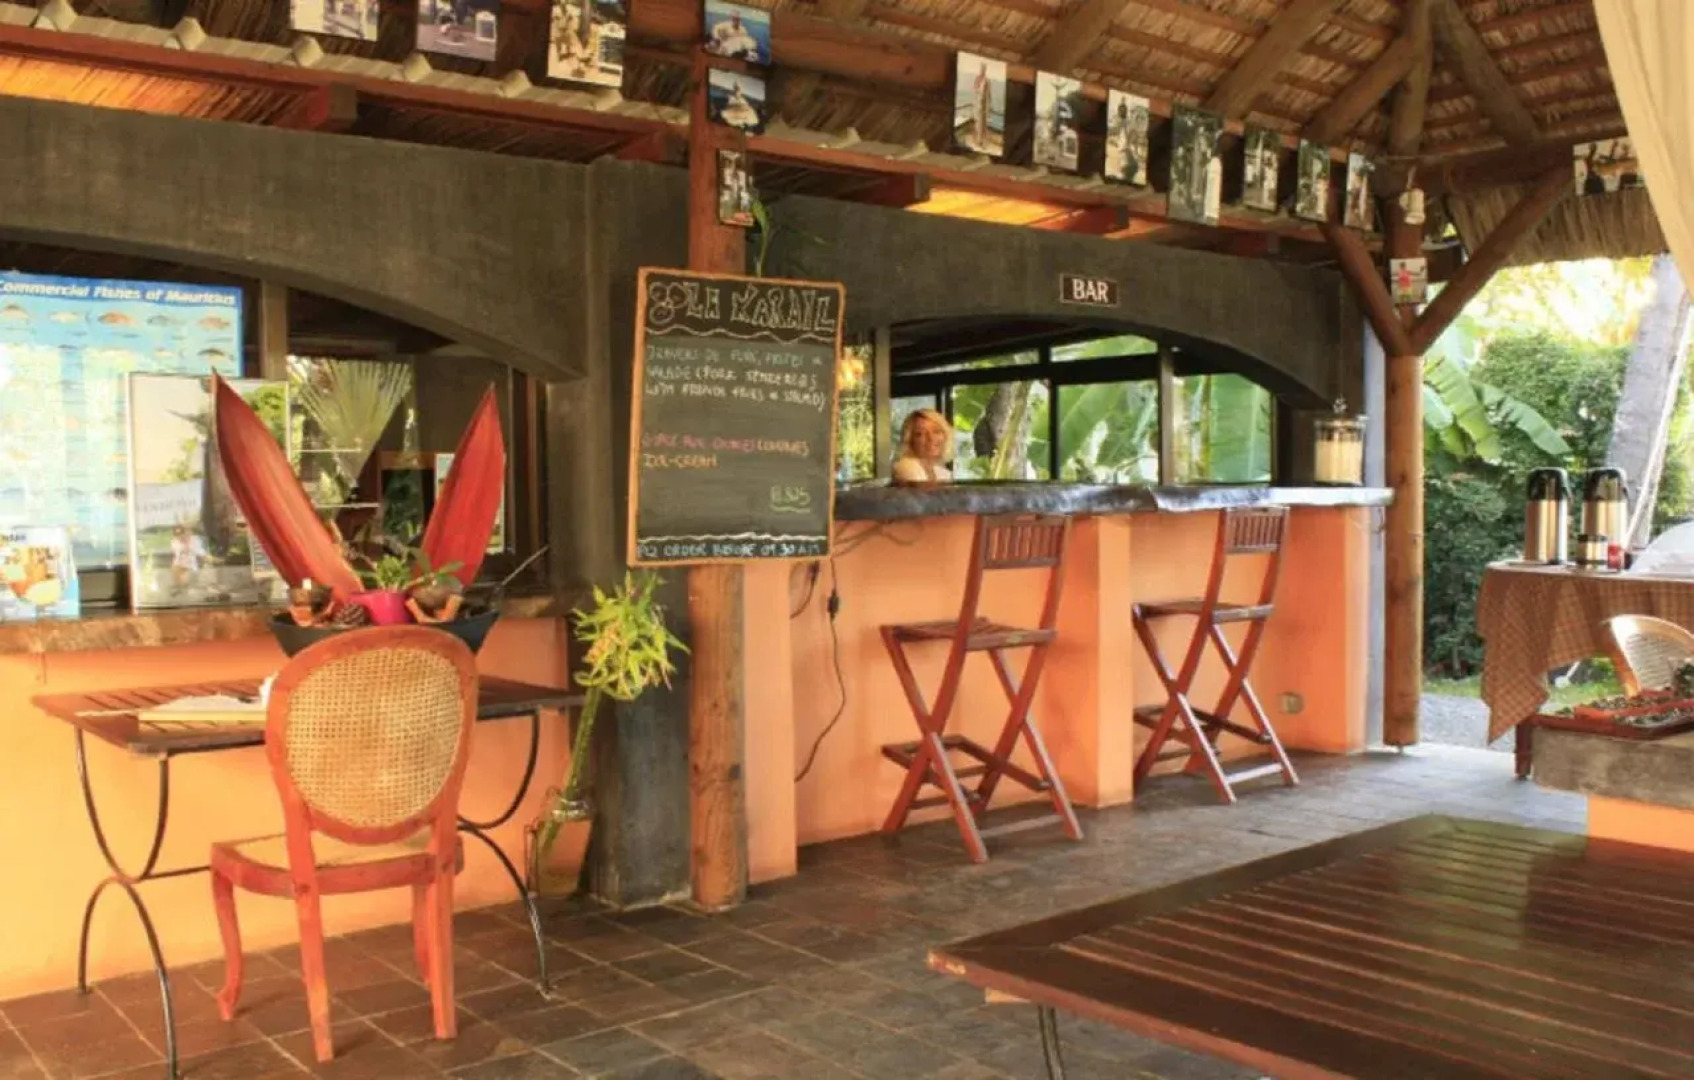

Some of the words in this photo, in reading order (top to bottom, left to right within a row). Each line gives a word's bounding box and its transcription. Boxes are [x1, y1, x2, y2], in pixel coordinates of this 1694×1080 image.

[93, 286, 141, 300] Fishes
[146, 290, 162, 301] of
[165, 291, 236, 305] Mauritius
[1072, 278, 1109, 303] BAR
